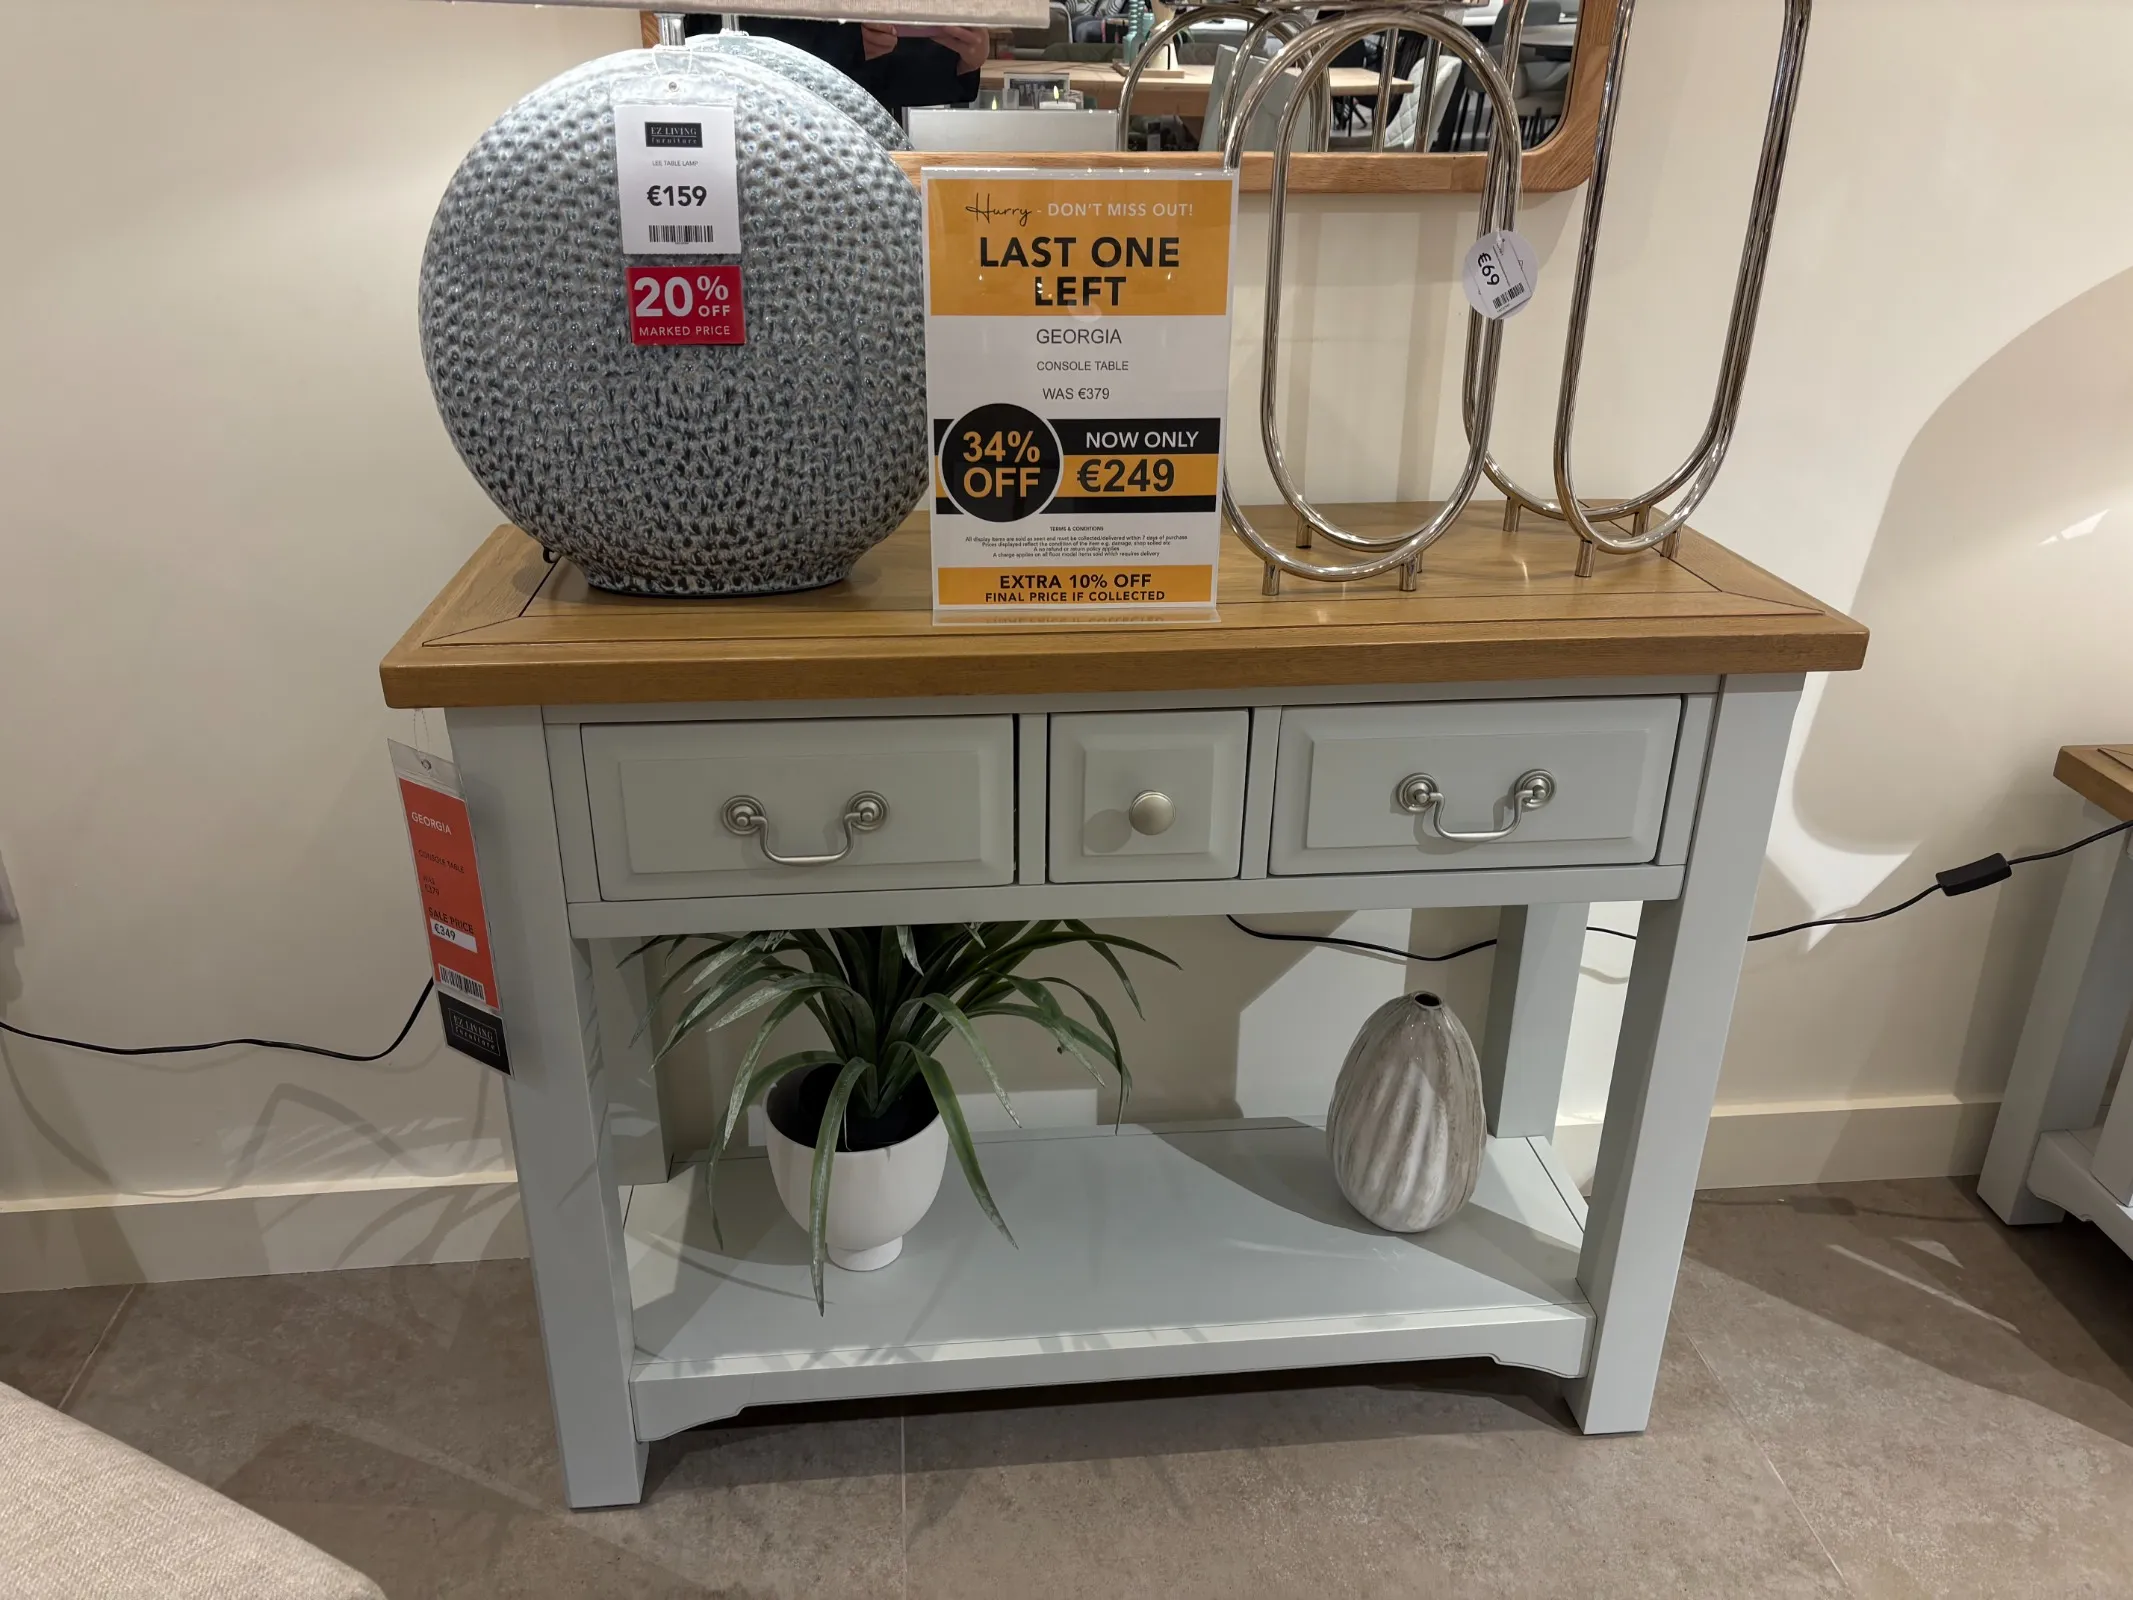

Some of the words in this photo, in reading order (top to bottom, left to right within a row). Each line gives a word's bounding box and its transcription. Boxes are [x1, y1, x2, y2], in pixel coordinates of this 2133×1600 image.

[651, 126, 662, 135] EZ
[665, 126, 697, 135] LIVING
[647, 185, 707, 206] €159
[965, 192, 1032, 227] Hurry
[1048, 203, 1102, 216] DON'T
[1108, 203, 1146, 216] MISS
[1152, 202, 1193, 216] OUT!
[980, 236, 1076, 268] LAST
[1091, 236, 1180, 268] ONE
[1477, 252, 1500, 286] €69
[634, 275, 729, 318] 20%
[698, 304, 730, 317] OFF
[1034, 276, 1126, 306] LEFT
[640, 326, 690, 336] MARKED
[695, 326, 730, 336] PRICE
[1036, 328, 1122, 344] GEORGIA
[1036, 361, 1092, 372] CONSOLE
[1094, 360, 1129, 371] TABLE
[1042, 388, 1074, 400] WAS
[1078, 388, 1110, 400] €379
[962, 430, 1041, 463] 34%
[1086, 432, 1140, 448] NOW
[1144, 431, 1199, 448] ONLY
[963, 466, 1041, 498] OFF
[1076, 458, 1175, 492] €249
[1000, 574, 1062, 589] EXTRA
[1069, 574, 1108, 588] 10%
[1114, 574, 1152, 588] OFF
[986, 592, 1025, 602] FINAL
[1029, 592, 1068, 602] PRICE
[1072, 592, 1084, 602] IF
[1088, 590, 1165, 602] COLLECTED
[411, 812, 452, 836] GEORGIA
[428, 906, 448, 924] SALE
[450, 916, 474, 934] PRICE
[434, 923, 456, 942] €349
